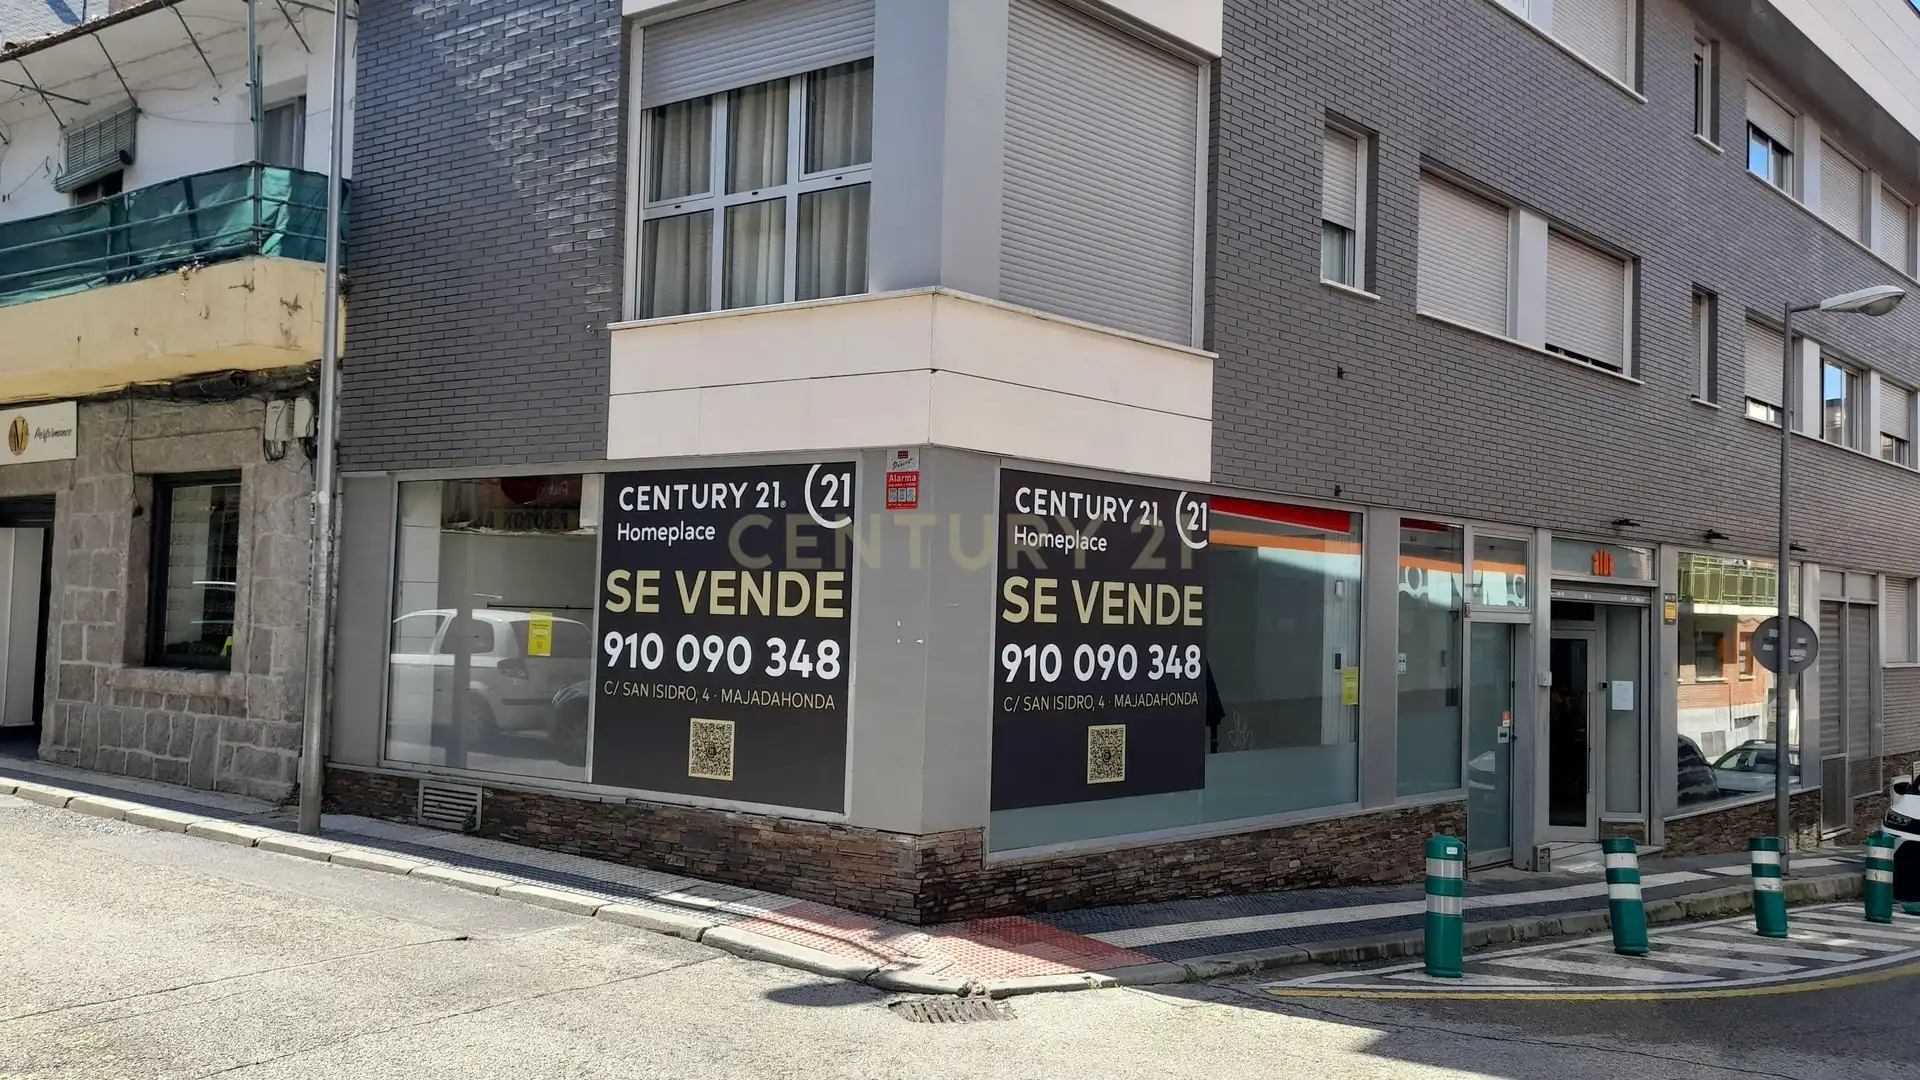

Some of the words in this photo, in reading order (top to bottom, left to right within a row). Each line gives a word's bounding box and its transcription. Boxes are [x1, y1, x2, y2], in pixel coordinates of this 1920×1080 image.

[888, 474, 917, 482] Alarma
[618, 482, 749, 511] CENTURY
[1015, 487, 1134, 524] CENTURY
[617, 522, 717, 547] Homeplace
[1014, 525, 1108, 554] Homeplace
[605, 569, 661, 613] SE
[676, 570, 845, 618] VENDE
[1002, 576, 1058, 623] SE
[1072, 580, 1204, 626] VENDE
[604, 631, 664, 670] 910
[676, 633, 753, 675] 090
[764, 637, 841, 680] 348
[1001, 643, 1063, 683] 910
[1073, 643, 1138, 682] 090
[1147, 643, 1202, 680] 348
[604, 681, 620, 696] C/
[623, 682, 649, 697] SAN
[652, 683, 699, 704] ISIDRO,
[702, 687, 711, 702] 4
[721, 689, 836, 711] MAJADAHONDA
[1003, 695, 1021, 713] C/
[1023, 696, 1050, 712] SAN
[1053, 695, 1096, 712] ISIDRO,
[1098, 695, 1106, 709] 4
[1114, 691, 1199, 709] MAJADAHONDA
